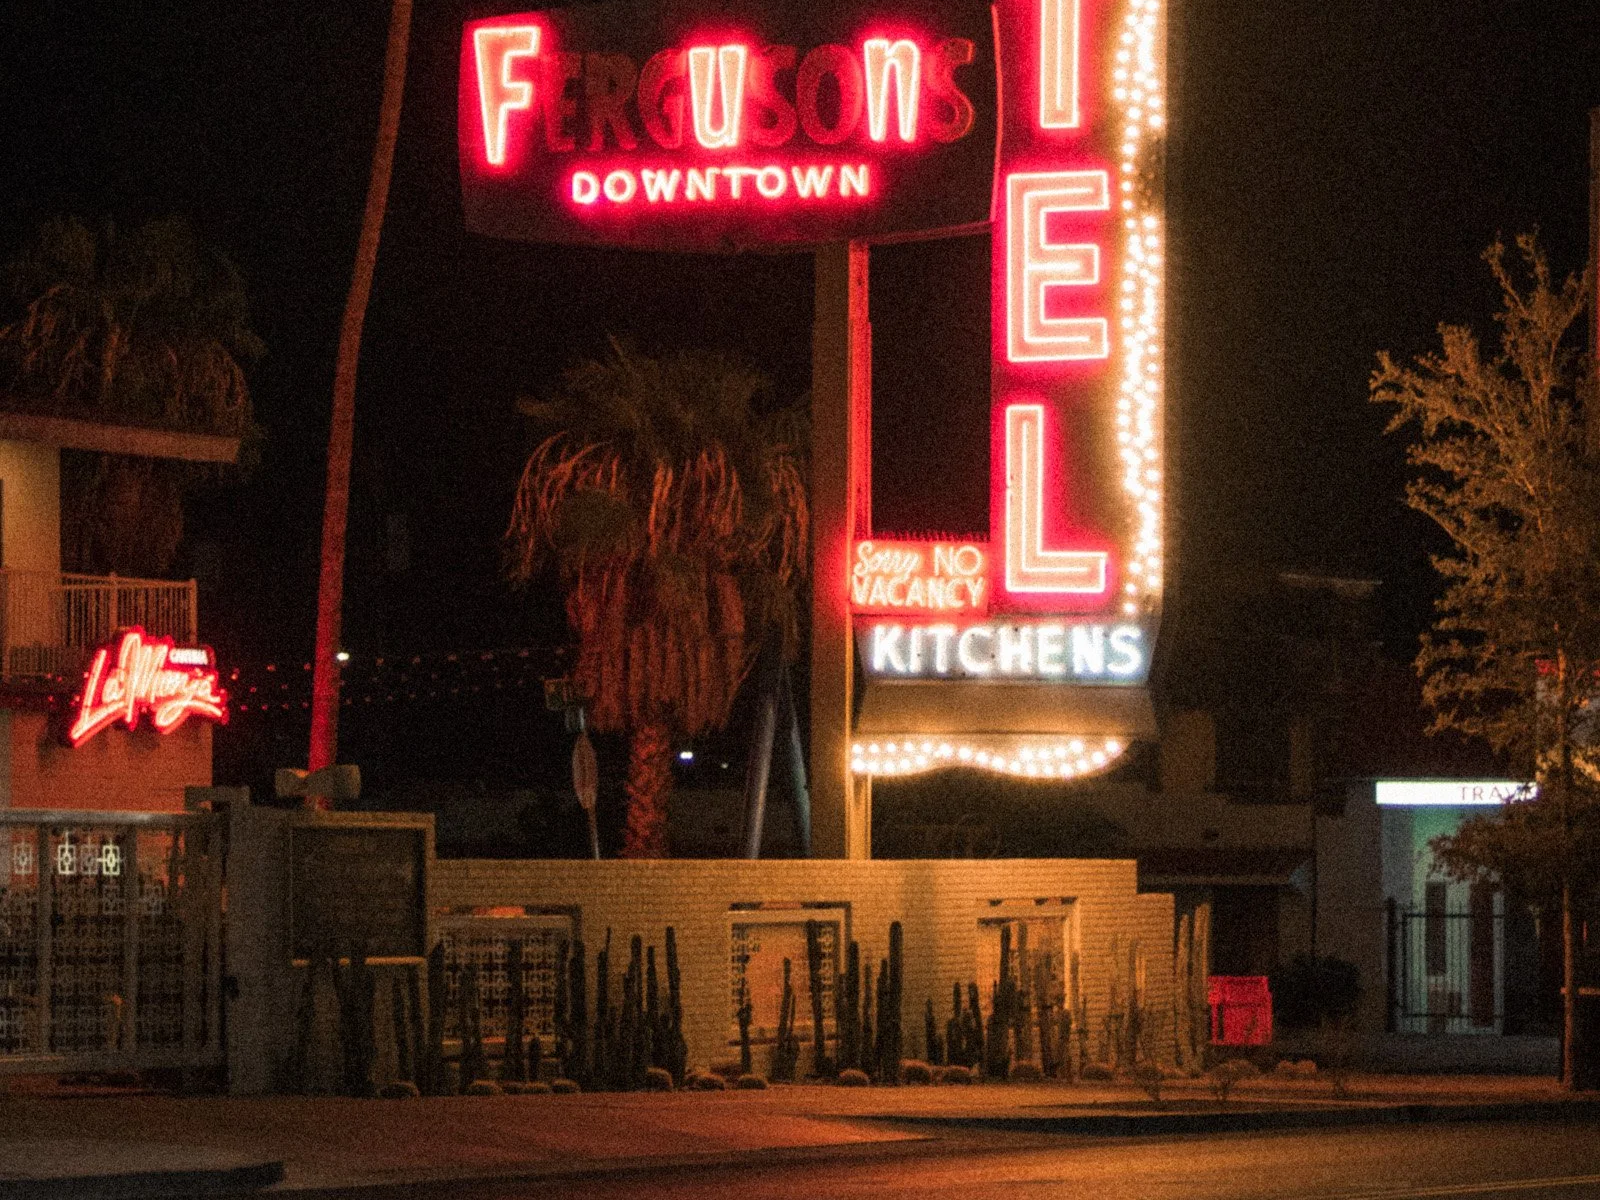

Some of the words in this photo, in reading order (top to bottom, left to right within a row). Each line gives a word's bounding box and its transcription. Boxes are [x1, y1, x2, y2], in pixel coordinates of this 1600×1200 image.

[571, 164, 871, 205] DOWNTOWN
[853, 541, 920, 581] Sorry
[933, 545, 983, 576] NO
[851, 574, 985, 609] VACANCY
[871, 624, 1143, 674] KITCHENS
